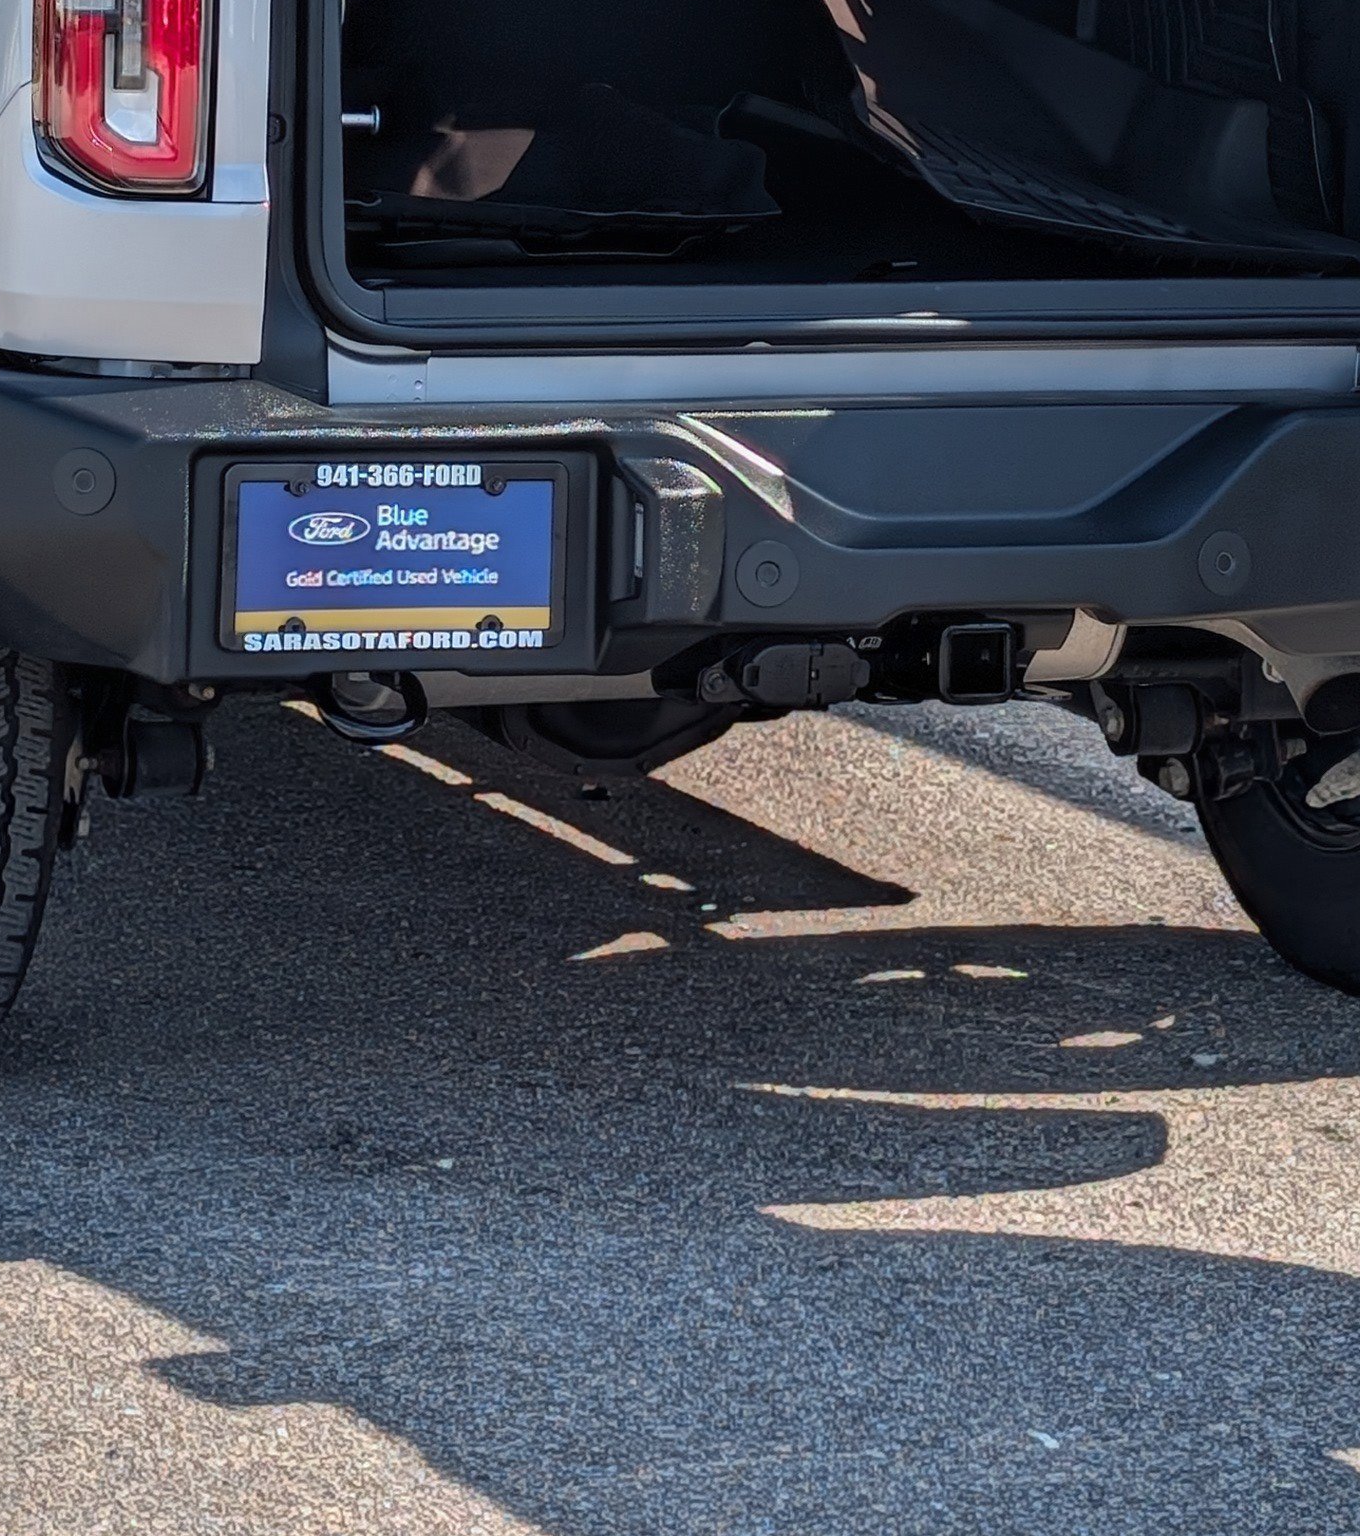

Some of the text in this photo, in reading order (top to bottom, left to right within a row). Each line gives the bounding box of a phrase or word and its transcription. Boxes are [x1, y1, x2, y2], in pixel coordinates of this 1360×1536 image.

[317, 464, 481, 488] 941-366-FORD
[376, 504, 429, 526] Blue
[300, 514, 356, 542] Ford
[375, 530, 500, 554] Advantage
[286, 568, 499, 588] Gold Certified Used Vehicle
[243, 630, 544, 652] SARASOTAFORD.COM
